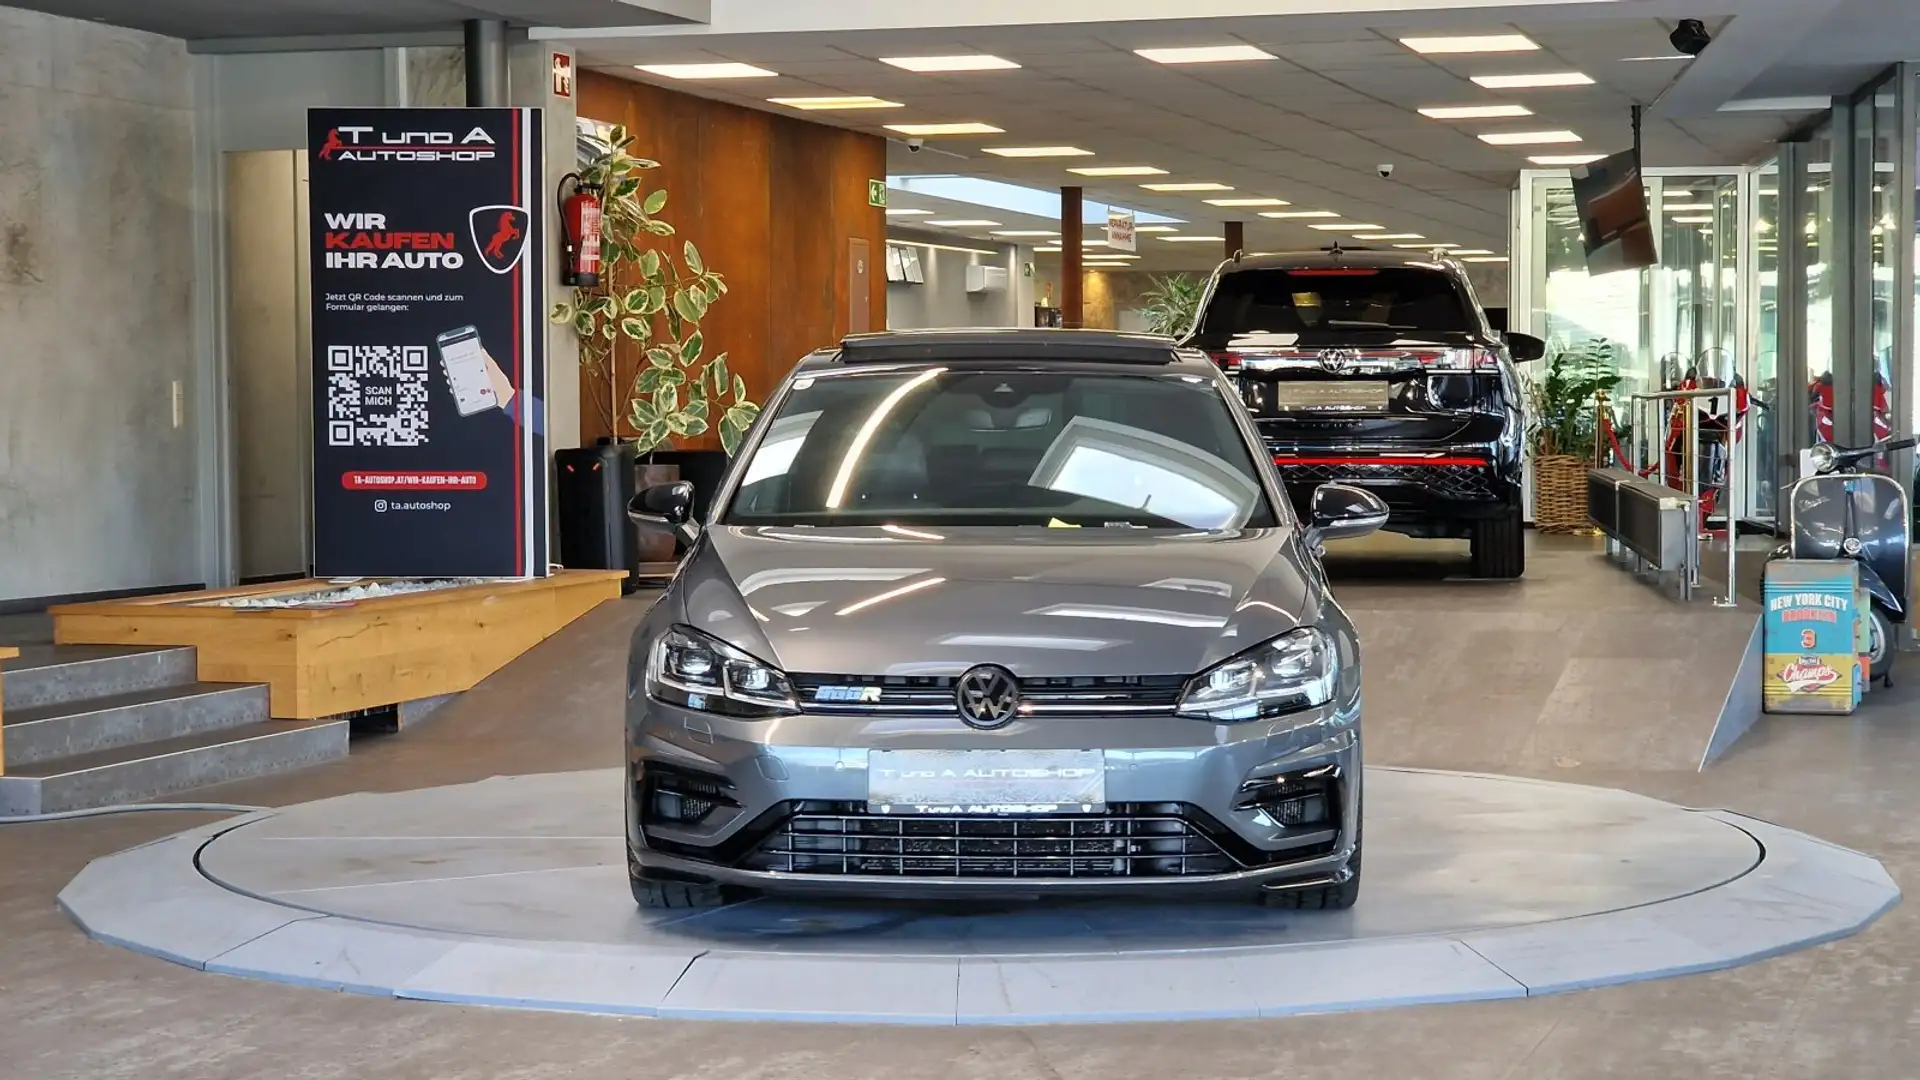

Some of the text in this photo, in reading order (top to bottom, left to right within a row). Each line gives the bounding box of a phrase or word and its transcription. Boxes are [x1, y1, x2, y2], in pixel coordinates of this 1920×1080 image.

[338, 126, 373, 144] T
[460, 126, 495, 144] A
[338, 151, 495, 161] AUTOSHOP
[324, 213, 386, 229] WIR
[325, 232, 454, 249] KAUFEN
[325, 252, 464, 269] IHR AUTO
[325, 293, 346, 301] Jetzt
[348, 293, 362, 302] QR
[363, 293, 386, 301] Code
[425, 293, 443, 301] und
[326, 303, 409, 312] Formular gelangen:
[364, 386, 393, 396] SCAN
[364, 396, 393, 406] MICH
[1708, 397, 1719, 416] 1
[391, 501, 451, 512] ta.autoshop
[1770, 593, 1848, 612] NEW YORK CITY
[1801, 628, 1816, 648] 3
[941, 769, 957, 778] A
[963, 768, 1096, 778] AUTOSHOP
[968, 805, 1058, 813] AUTOSHOP
